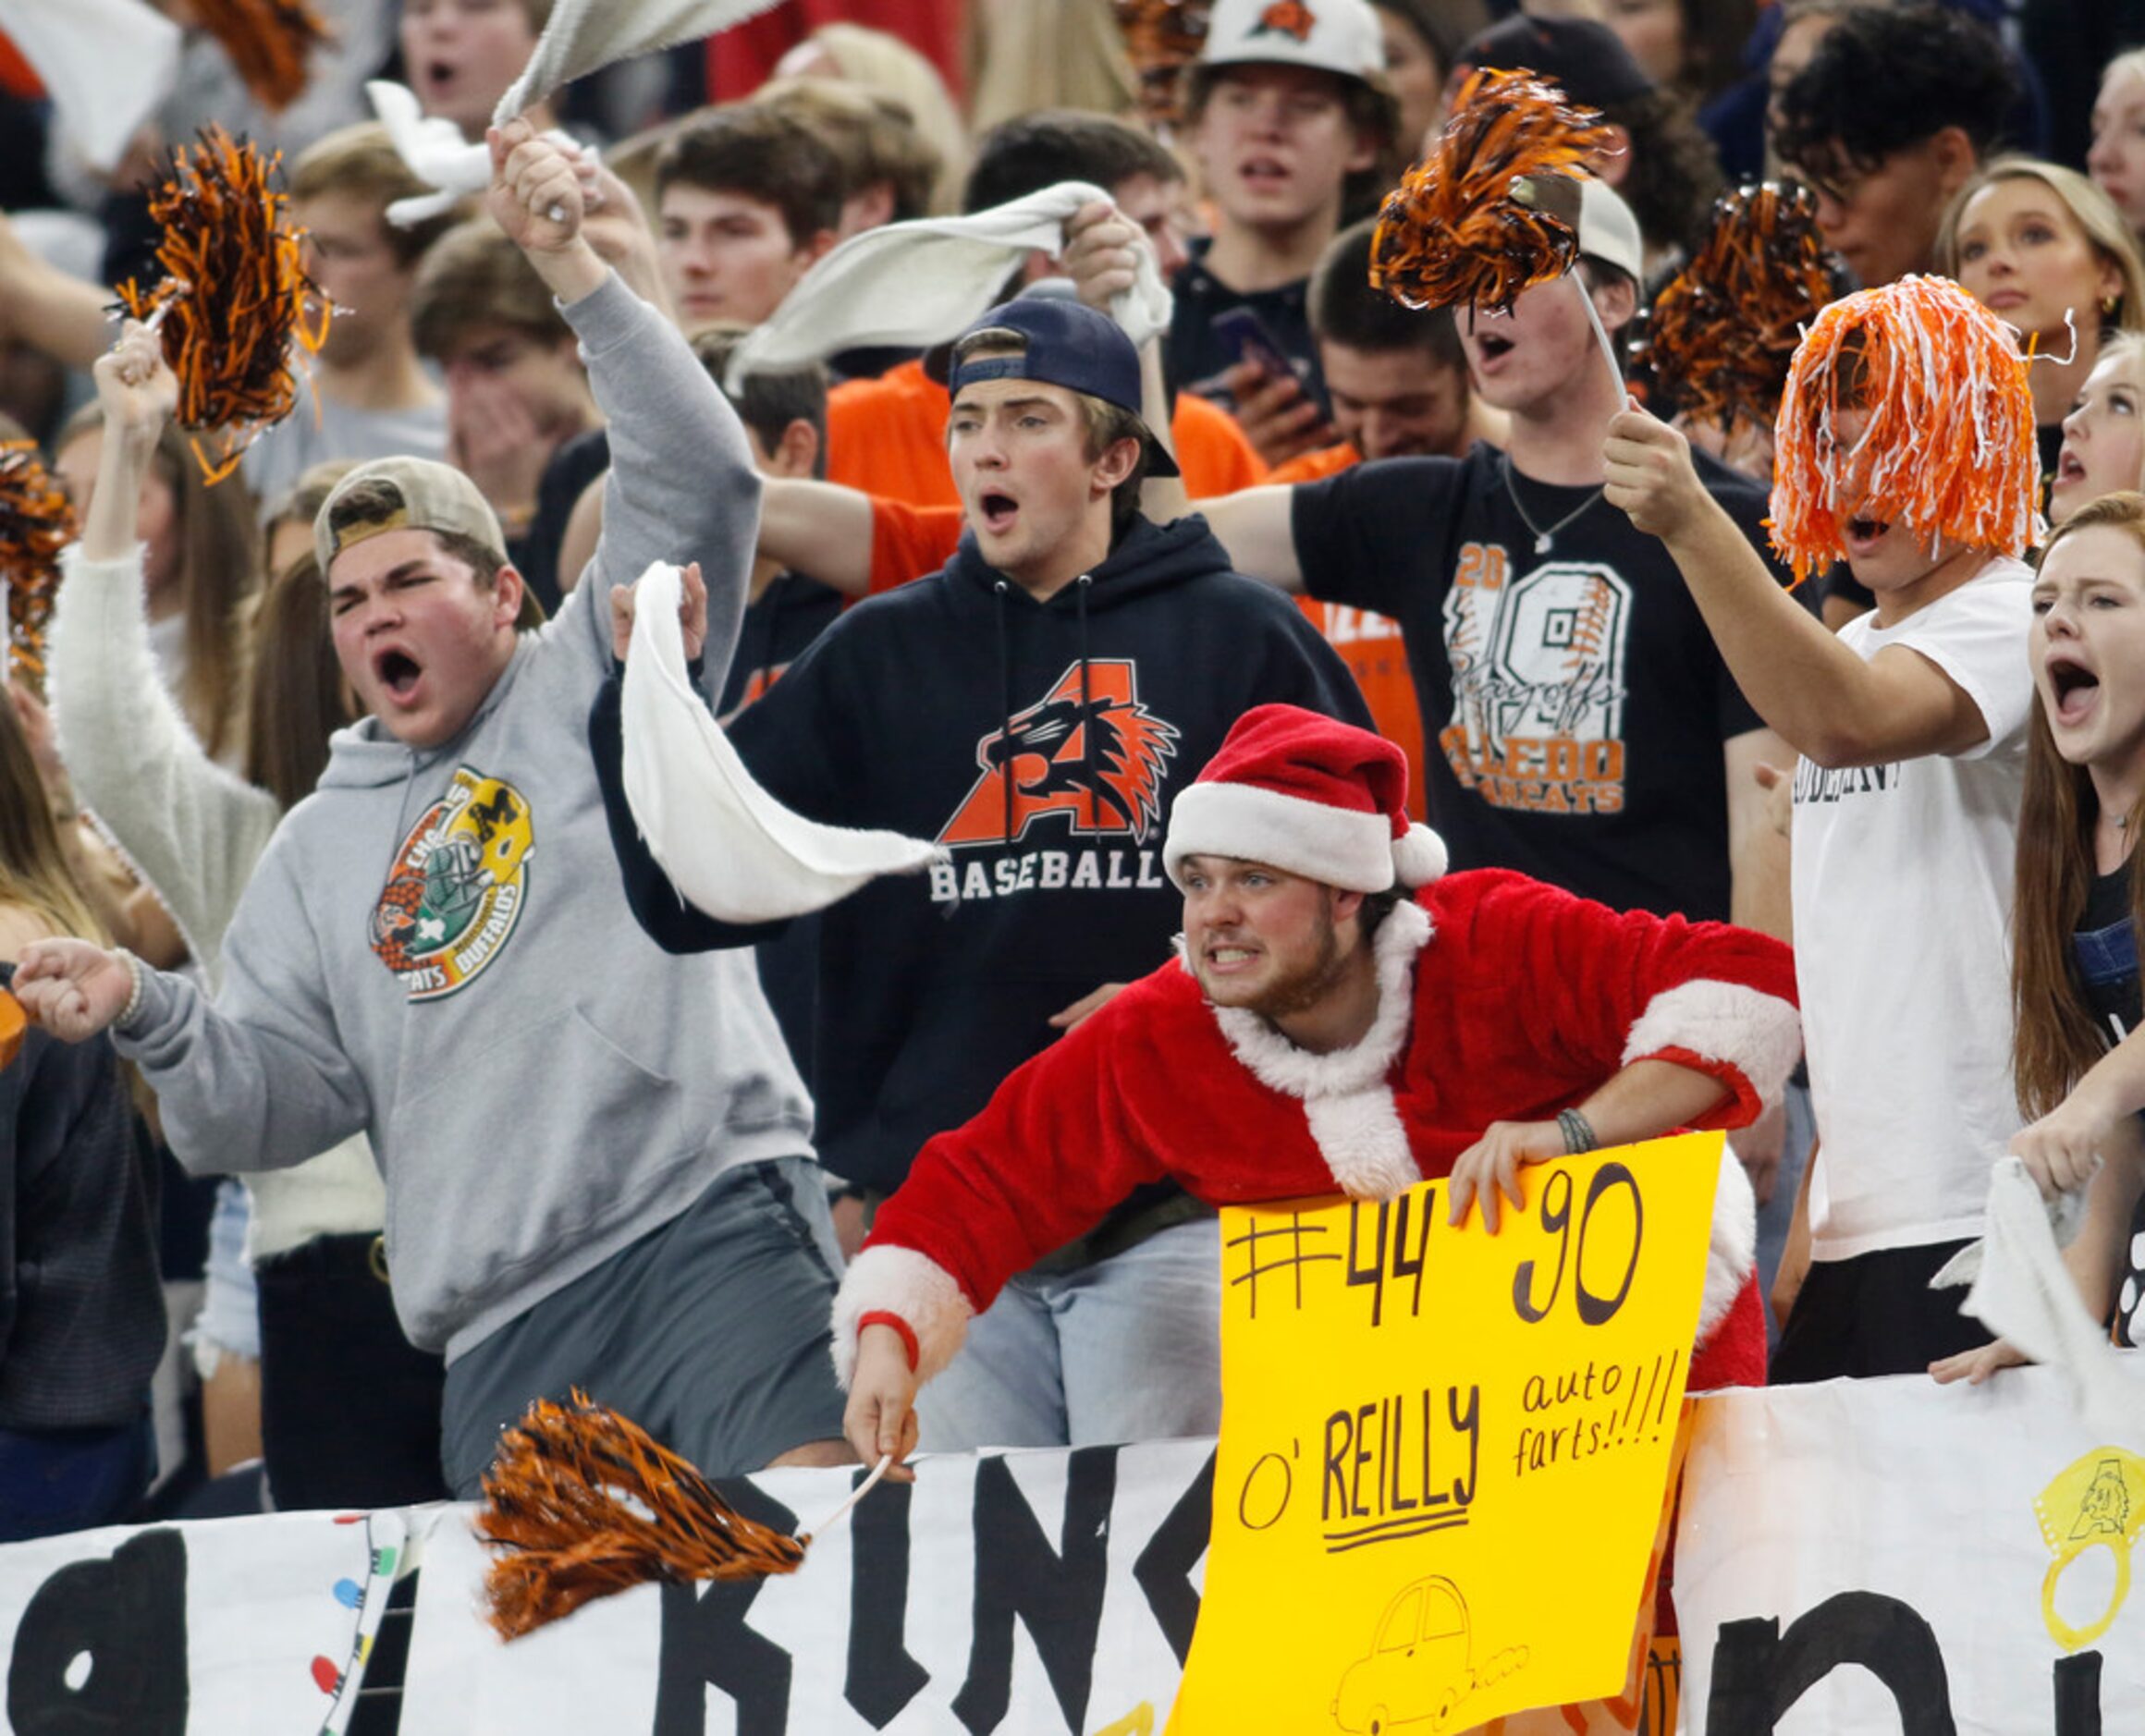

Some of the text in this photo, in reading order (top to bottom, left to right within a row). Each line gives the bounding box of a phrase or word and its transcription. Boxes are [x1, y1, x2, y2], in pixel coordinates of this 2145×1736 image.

[1455, 544, 1506, 590] 20
[928, 850, 1164, 902] BASEBALL
[1522, 1361, 1623, 1412] auto
